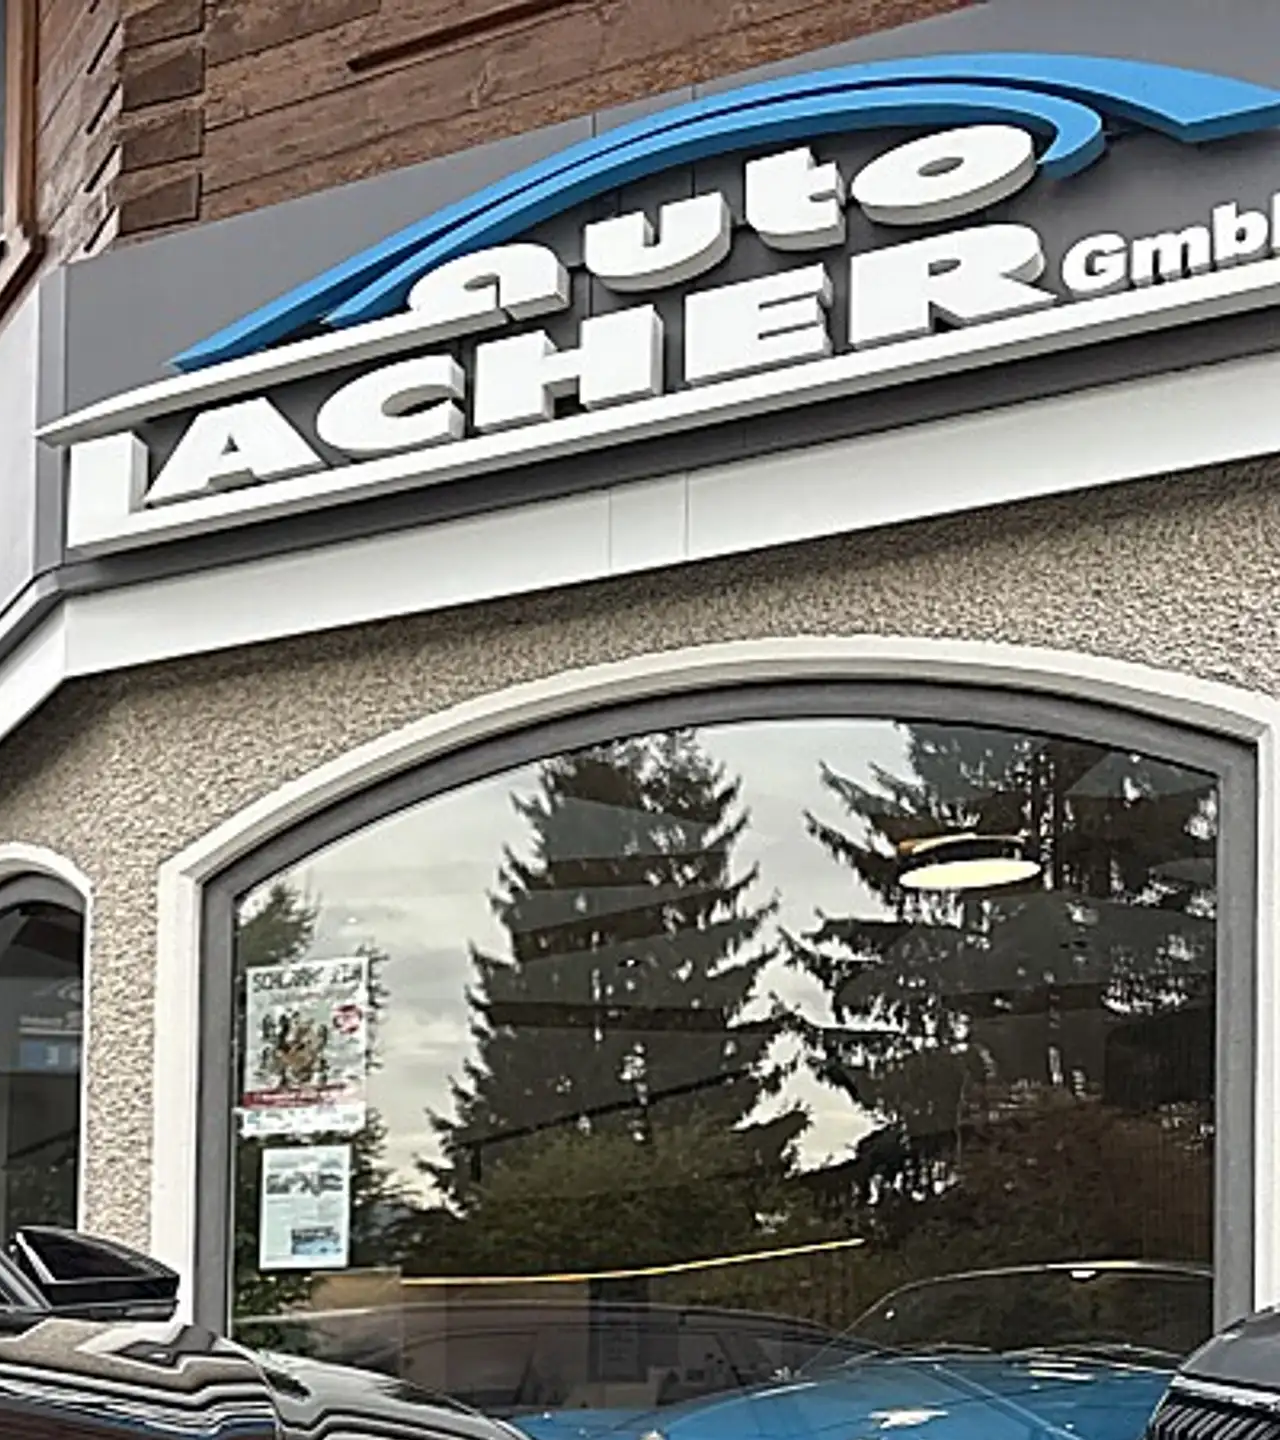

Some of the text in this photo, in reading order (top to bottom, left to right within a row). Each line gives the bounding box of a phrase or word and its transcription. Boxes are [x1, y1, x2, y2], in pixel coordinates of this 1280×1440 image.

[407, 123, 1039, 322] auto
[65, 190, 1280, 550] LACHER Gmb
